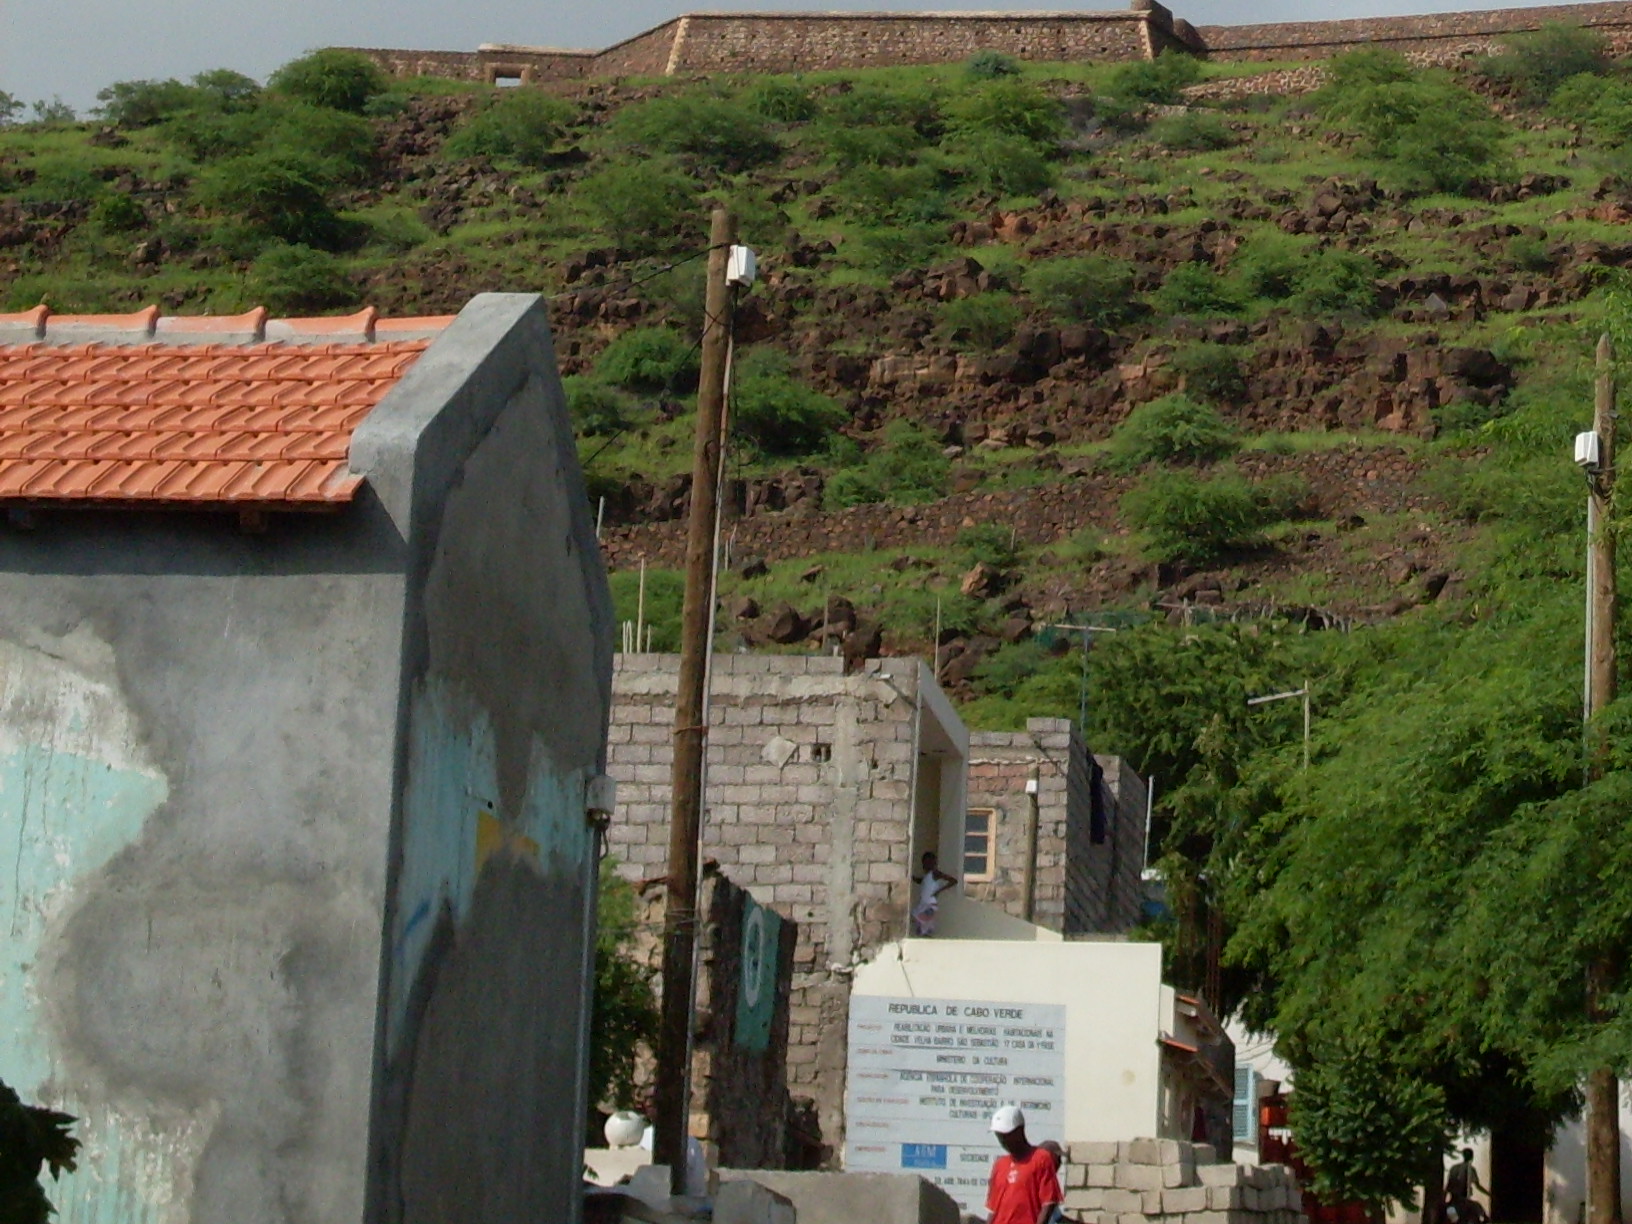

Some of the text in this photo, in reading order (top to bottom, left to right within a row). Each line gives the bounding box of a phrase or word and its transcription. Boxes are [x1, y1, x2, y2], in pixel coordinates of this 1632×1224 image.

[946, 1006, 958, 1016] DE
[964, 1007, 990, 1018] CABO
[994, 1009, 1023, 1019] VERDE
